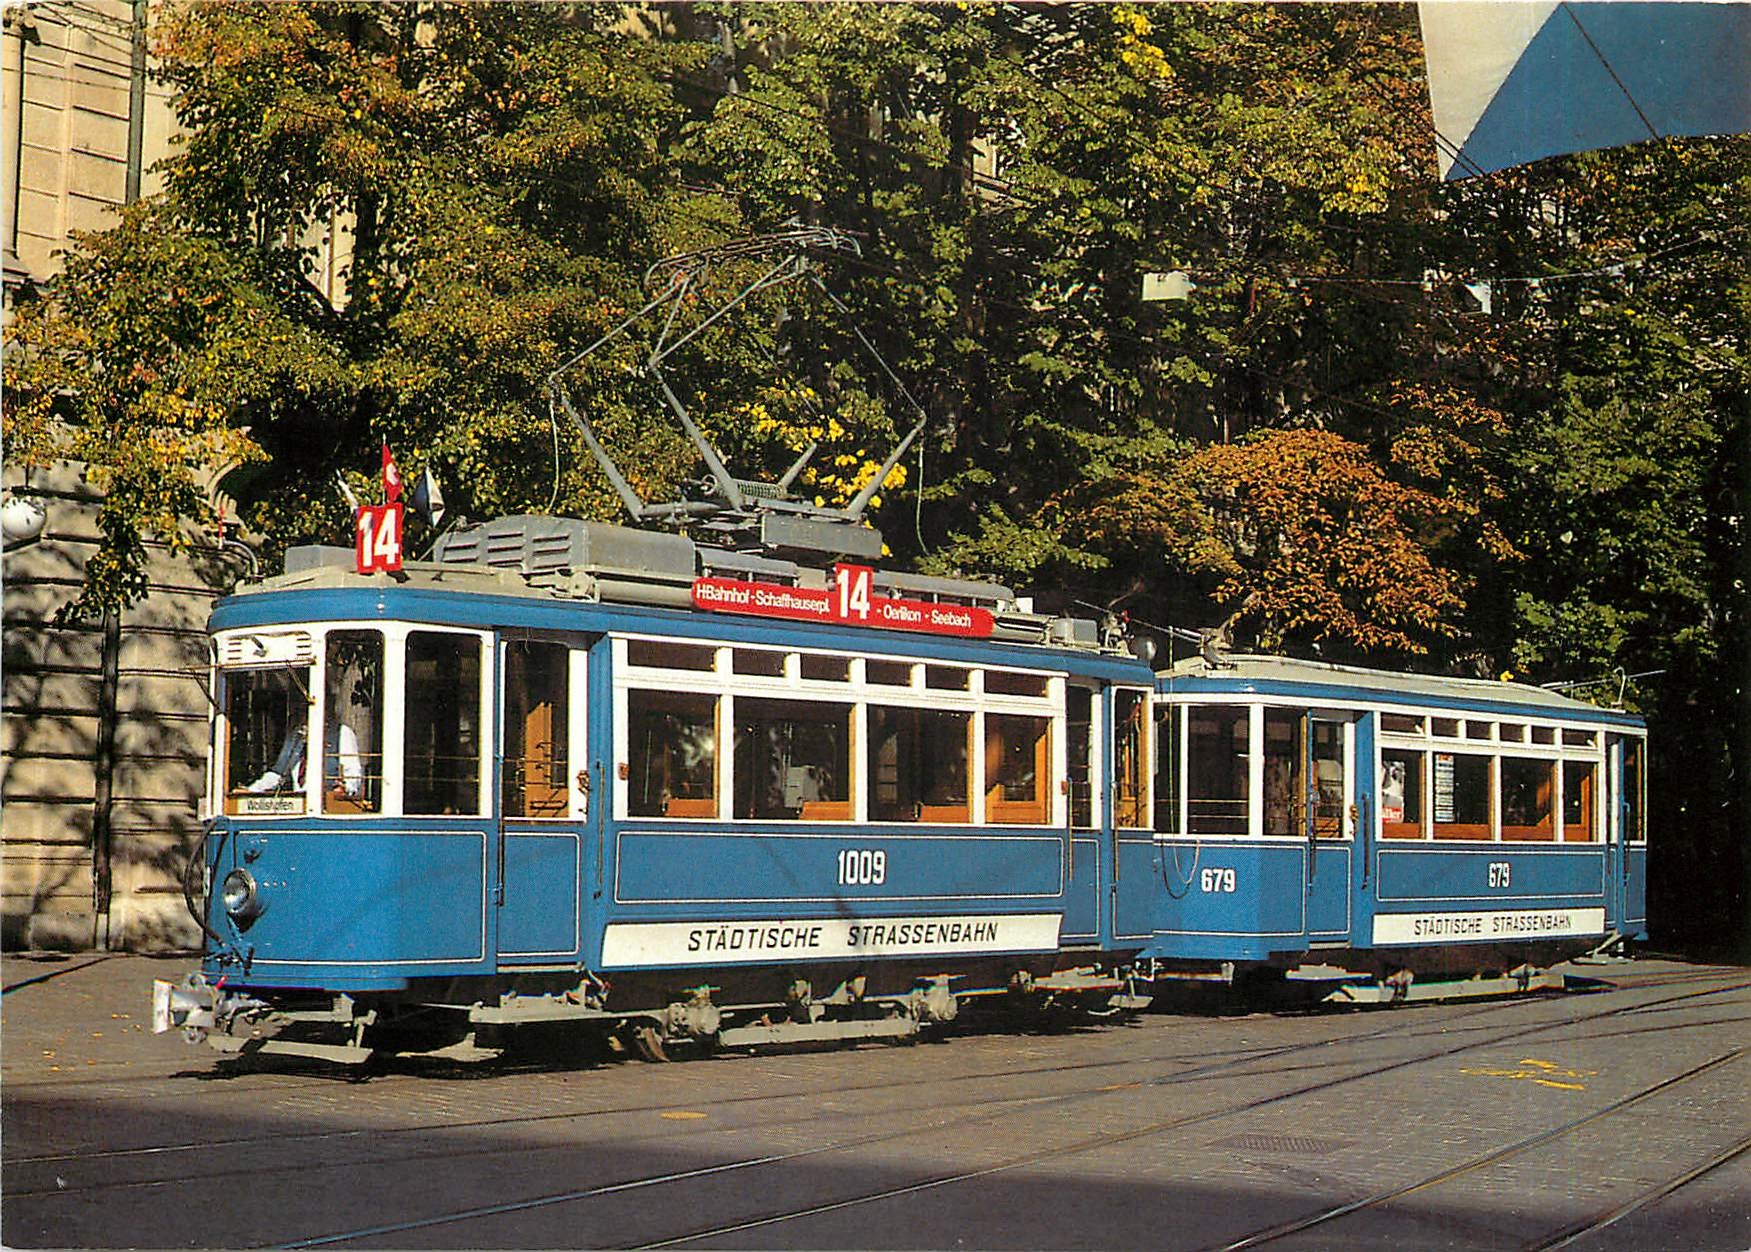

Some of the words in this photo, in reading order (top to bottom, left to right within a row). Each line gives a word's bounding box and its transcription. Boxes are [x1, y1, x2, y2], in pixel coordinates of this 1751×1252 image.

[359, 508, 400, 567] 14
[837, 568, 871, 620] 14
[883, 604, 922, 623] Oerlikon
[931, 608, 972, 628] Seebach
[837, 850, 886, 886] 1009
[1200, 867, 1237, 893] 679
[1487, 861, 1511, 888] 679
[688, 924, 823, 951] STÄDTISCHE
[848, 922, 998, 946] STRASSENBAHN
[1415, 916, 1484, 937] STÄDTISCHE
[1493, 913, 1573, 933] STRASSENBAHN
